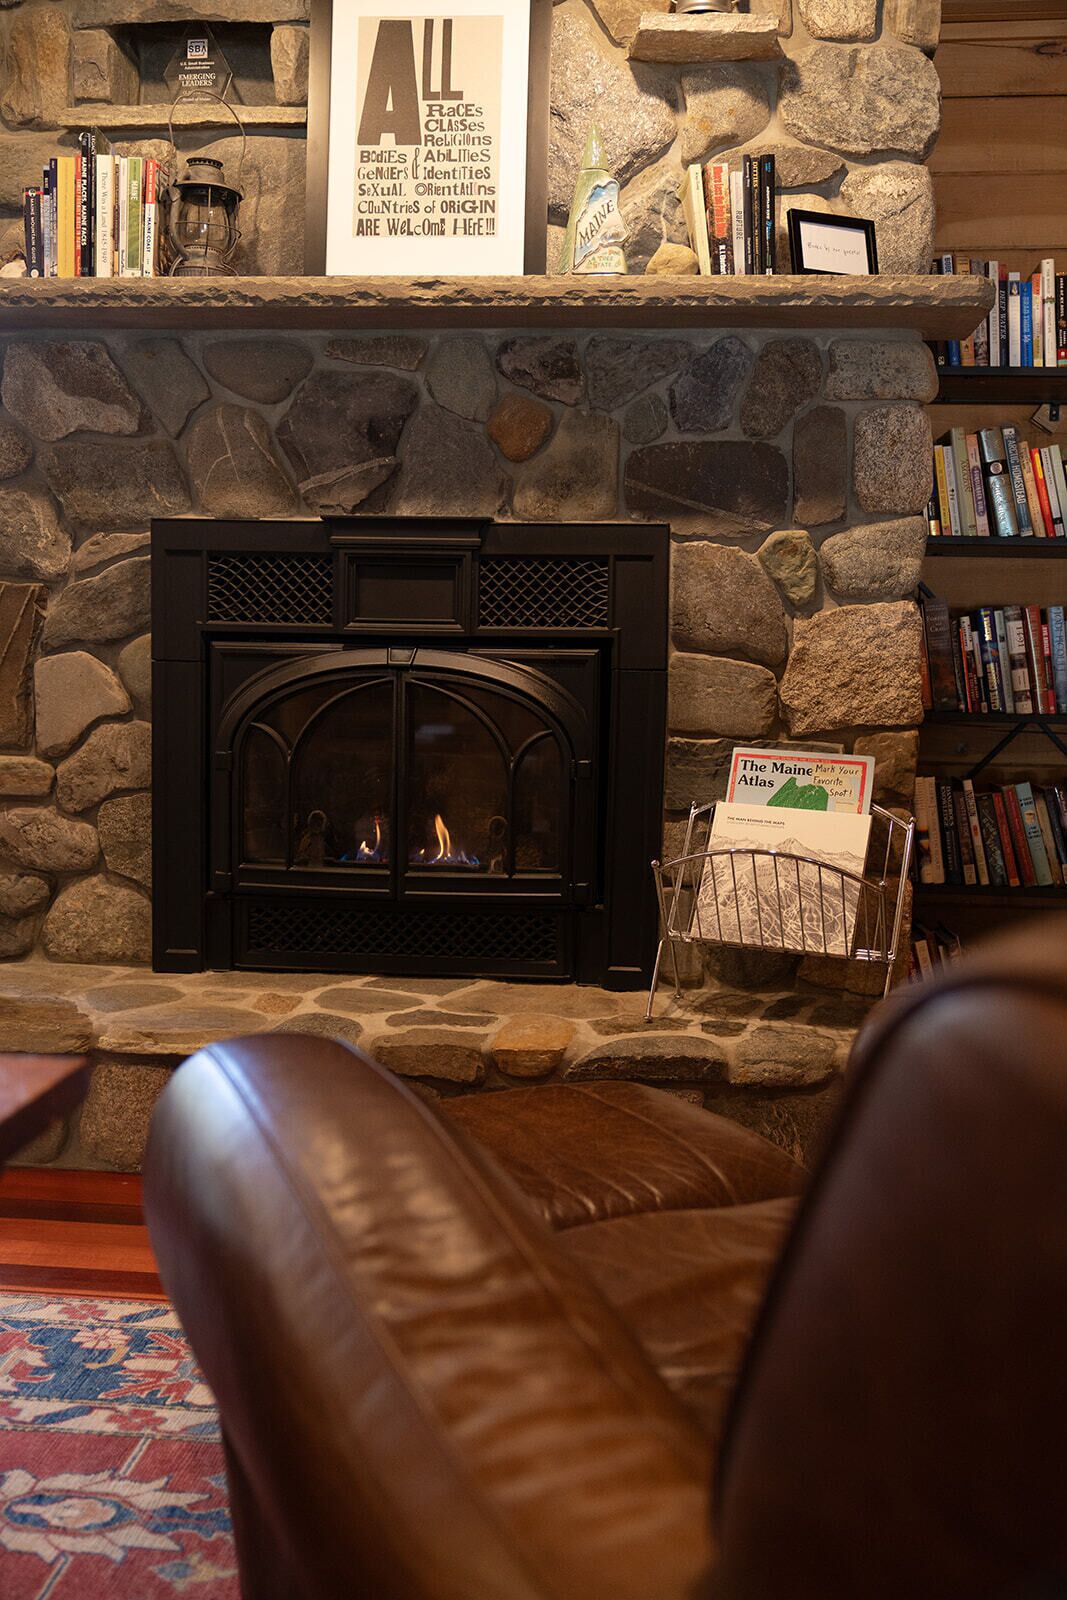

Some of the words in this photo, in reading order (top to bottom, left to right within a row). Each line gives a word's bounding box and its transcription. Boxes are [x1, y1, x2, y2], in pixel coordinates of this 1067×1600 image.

[188, 45, 207, 53] SBA
[357, 19, 463, 145] ALL
[130, 180, 138, 201] MAINE
[424, 200, 436, 214] of
[356, 218, 380, 236] ARE
[579, 200, 615, 250] MAINE
[735, 210, 743, 241] RUPTURE
[999, 290, 1007, 312] DEEP
[999, 313, 1007, 341] WATER
[1007, 439, 1019, 464] ARCTIC
[1010, 464, 1027, 505] HOMESTEAD
[740, 759, 767, 774] The
[771, 762, 813, 776] Maine
[815, 764, 836, 774] Mark
[839, 766, 859, 775] Your
[738, 774, 775, 788] Atlas
[813, 776, 843, 787] Favorite
